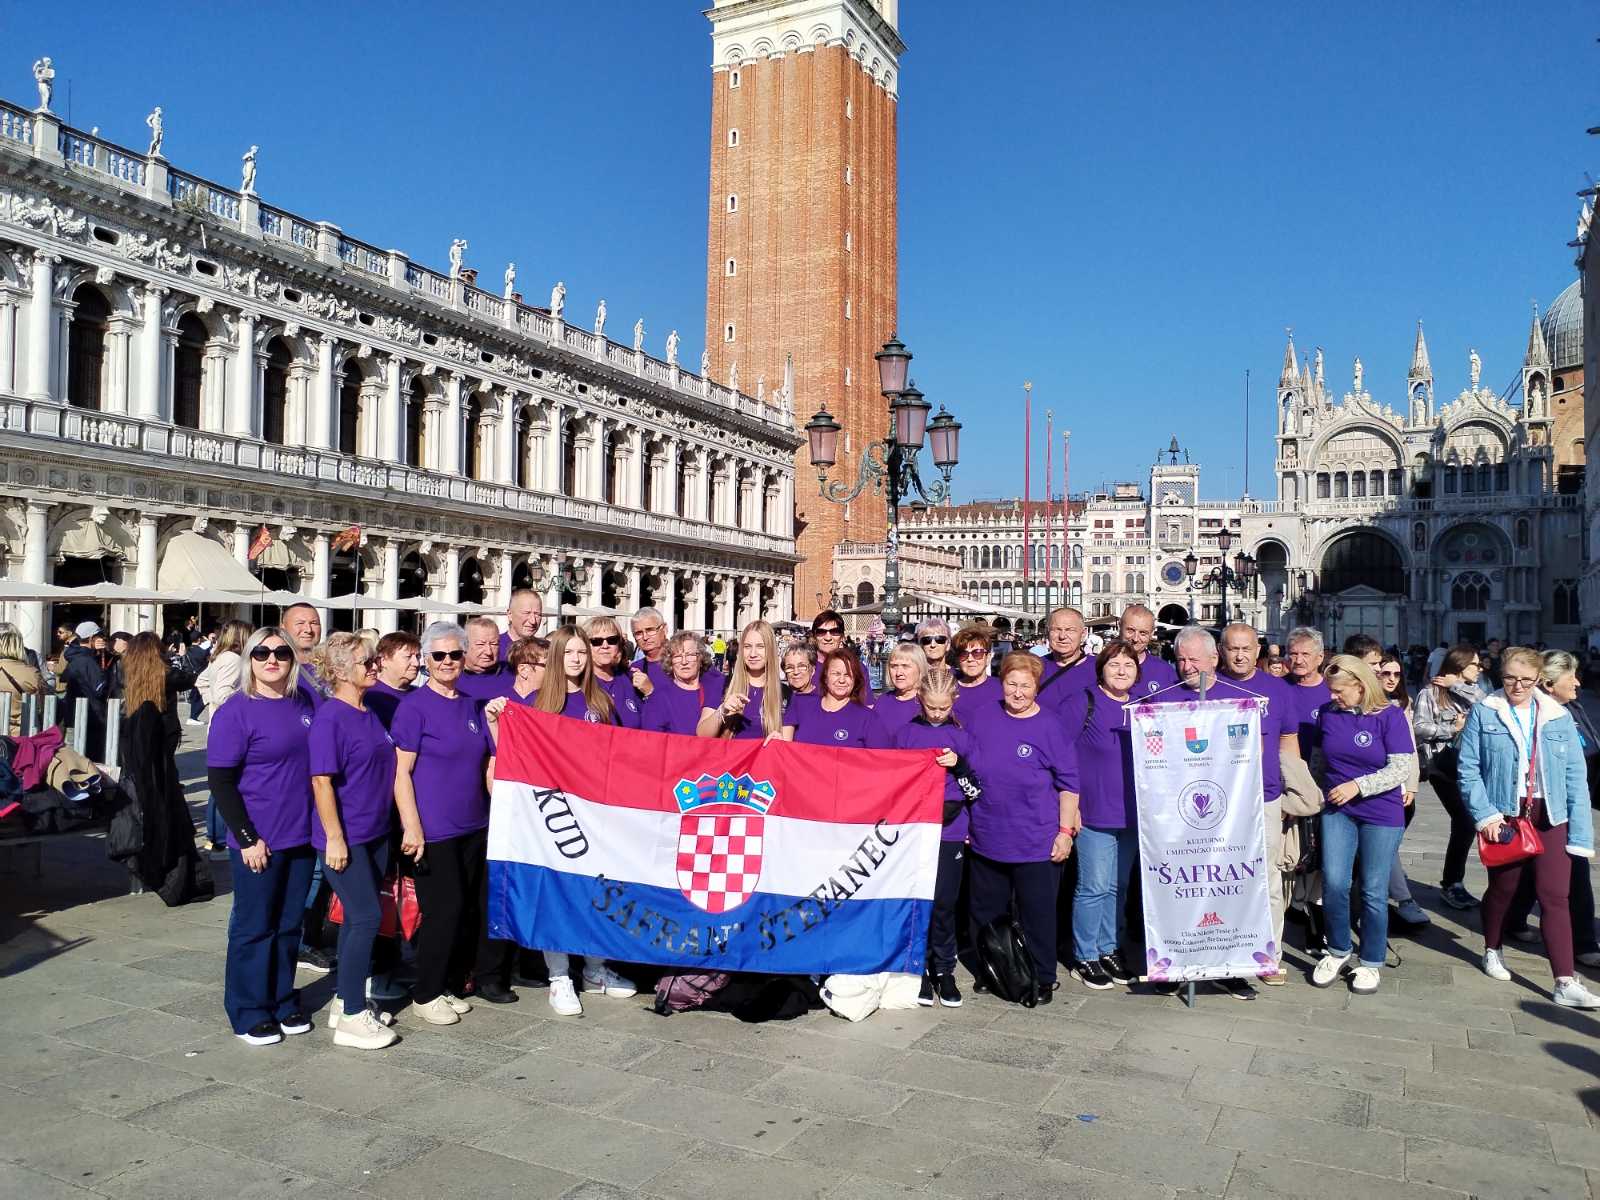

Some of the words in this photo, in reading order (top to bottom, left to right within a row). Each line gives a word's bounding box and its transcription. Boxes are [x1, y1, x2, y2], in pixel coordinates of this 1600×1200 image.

[533, 788, 589, 859] KUD
[758, 818, 900, 951] ŠTEFANEC
[1175, 885, 1244, 899] ŠTEFANEC
